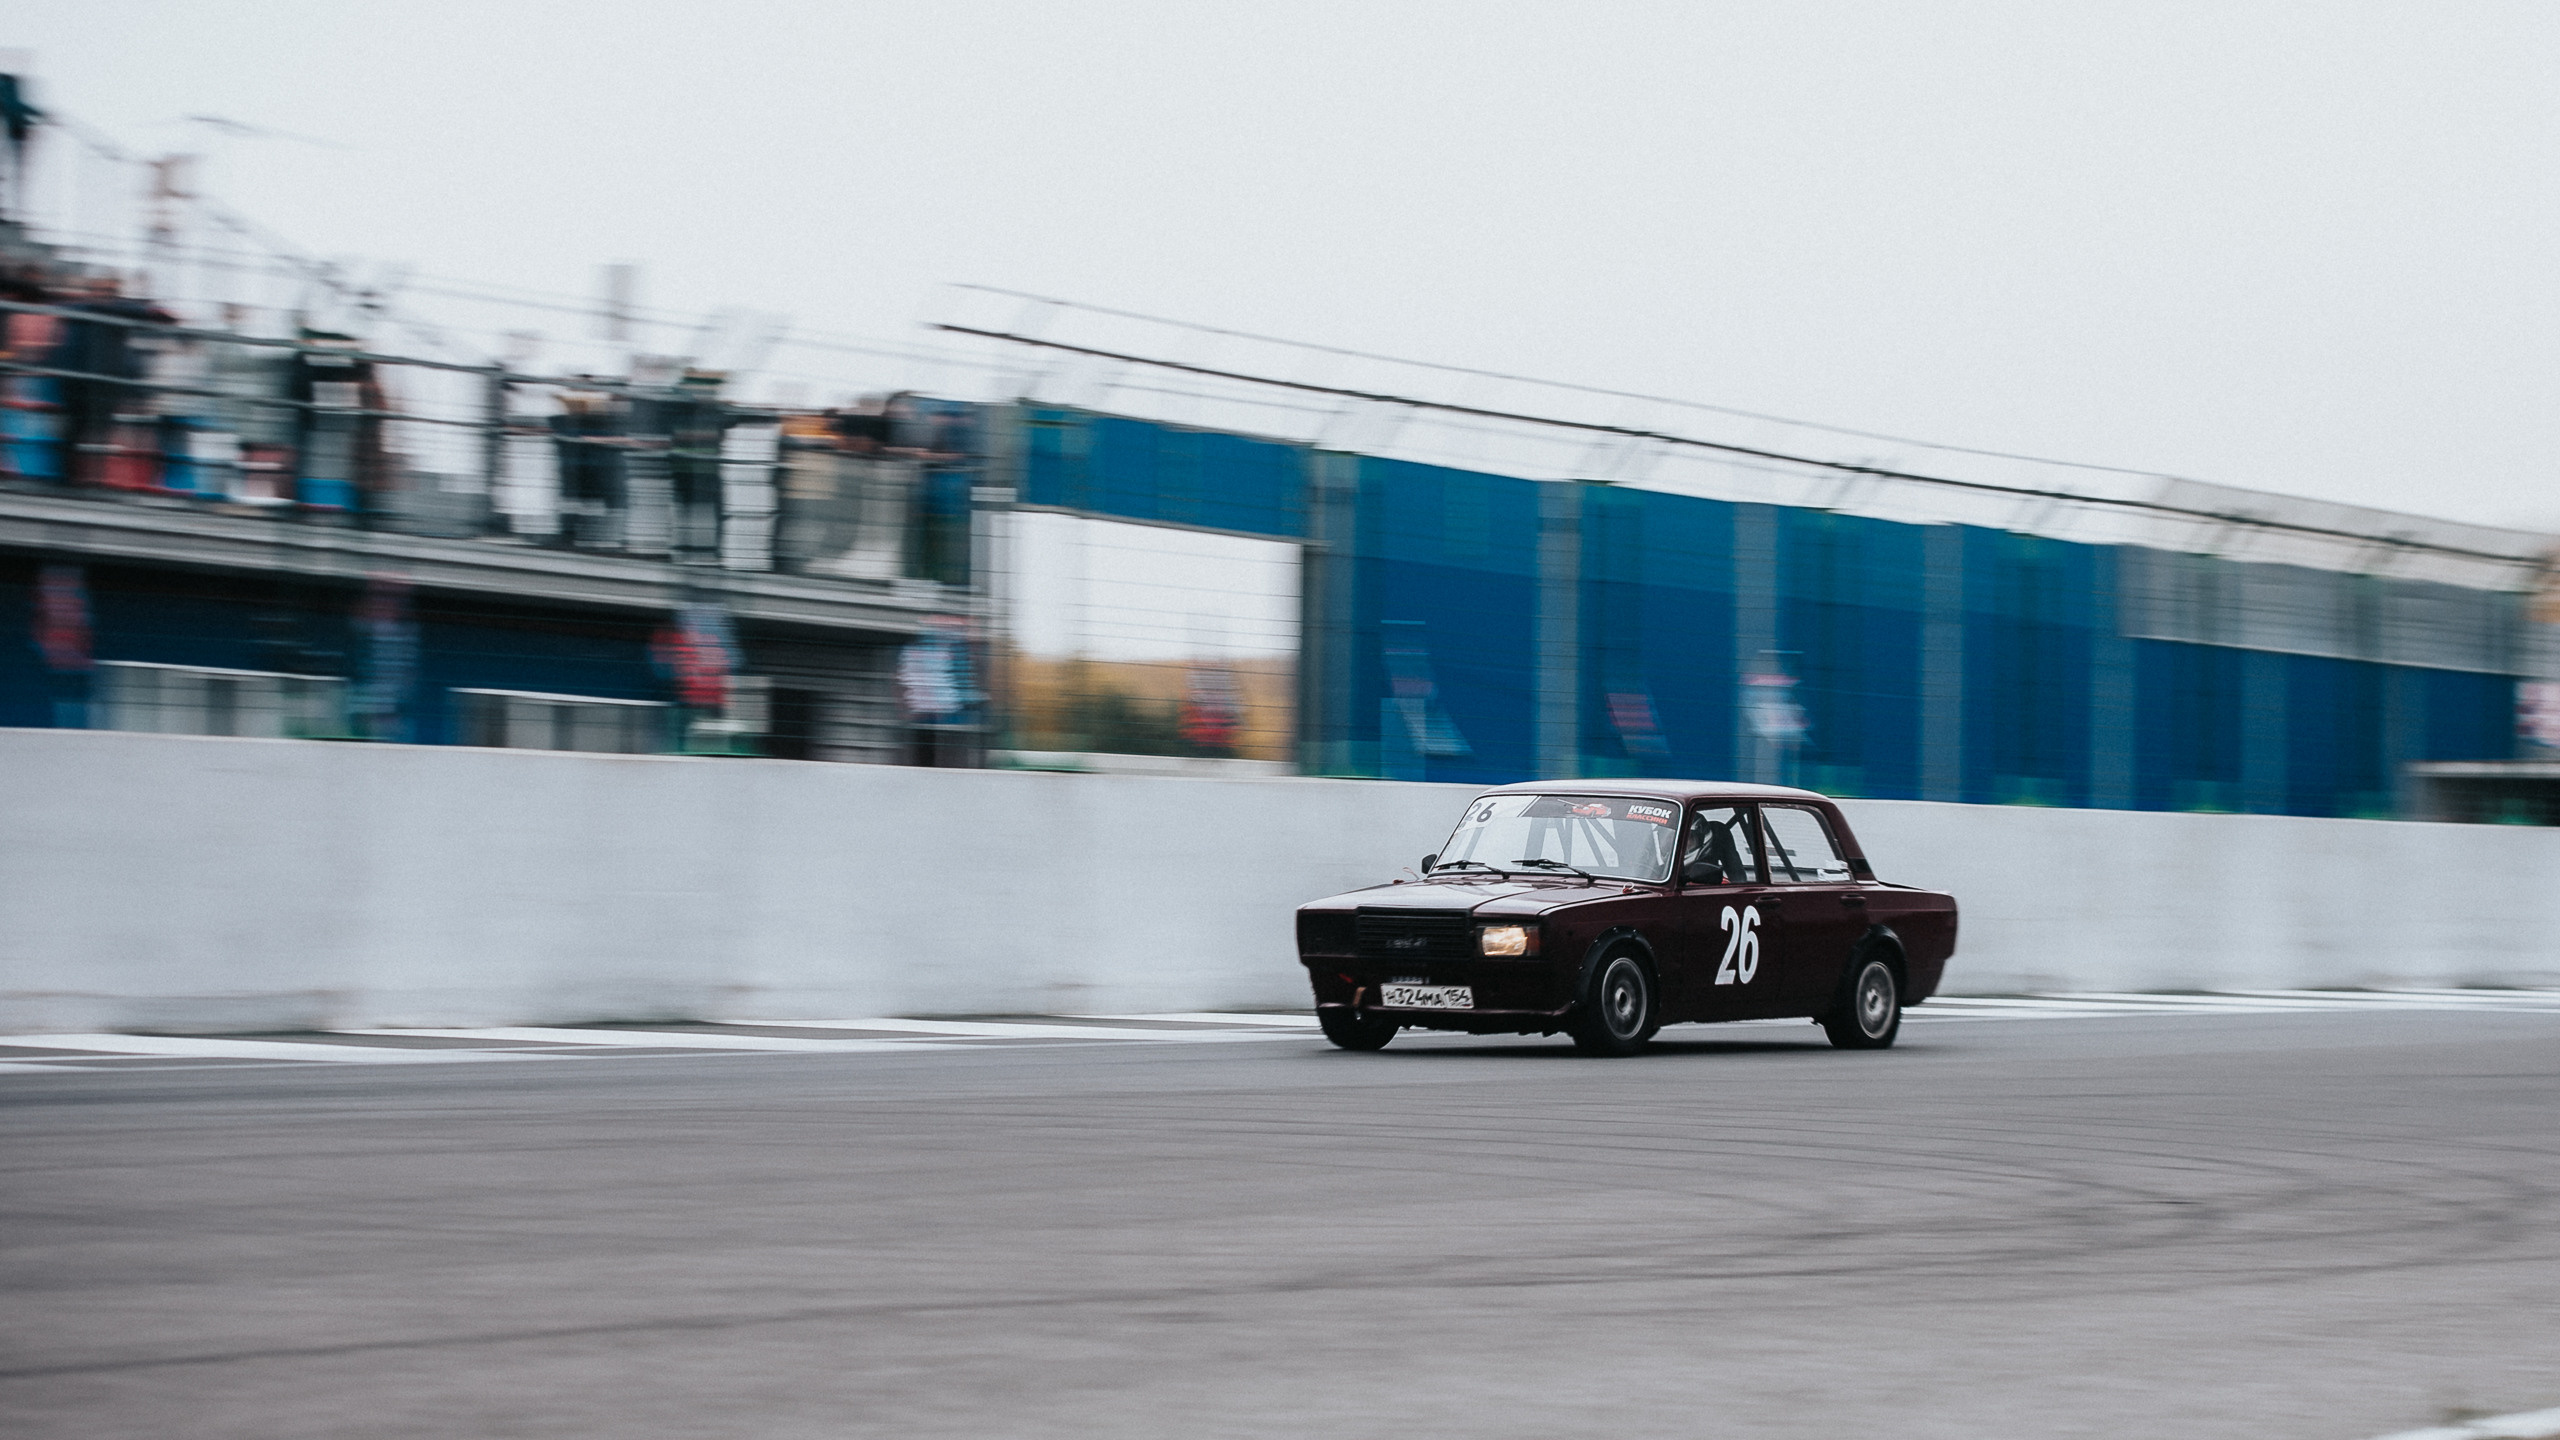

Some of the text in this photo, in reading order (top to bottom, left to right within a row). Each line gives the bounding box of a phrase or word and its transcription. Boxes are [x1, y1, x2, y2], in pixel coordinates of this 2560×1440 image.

[1464, 802, 1496, 822] 26
[1628, 804, 1672, 819] КУБОК
[1714, 905, 1761, 985] 26
